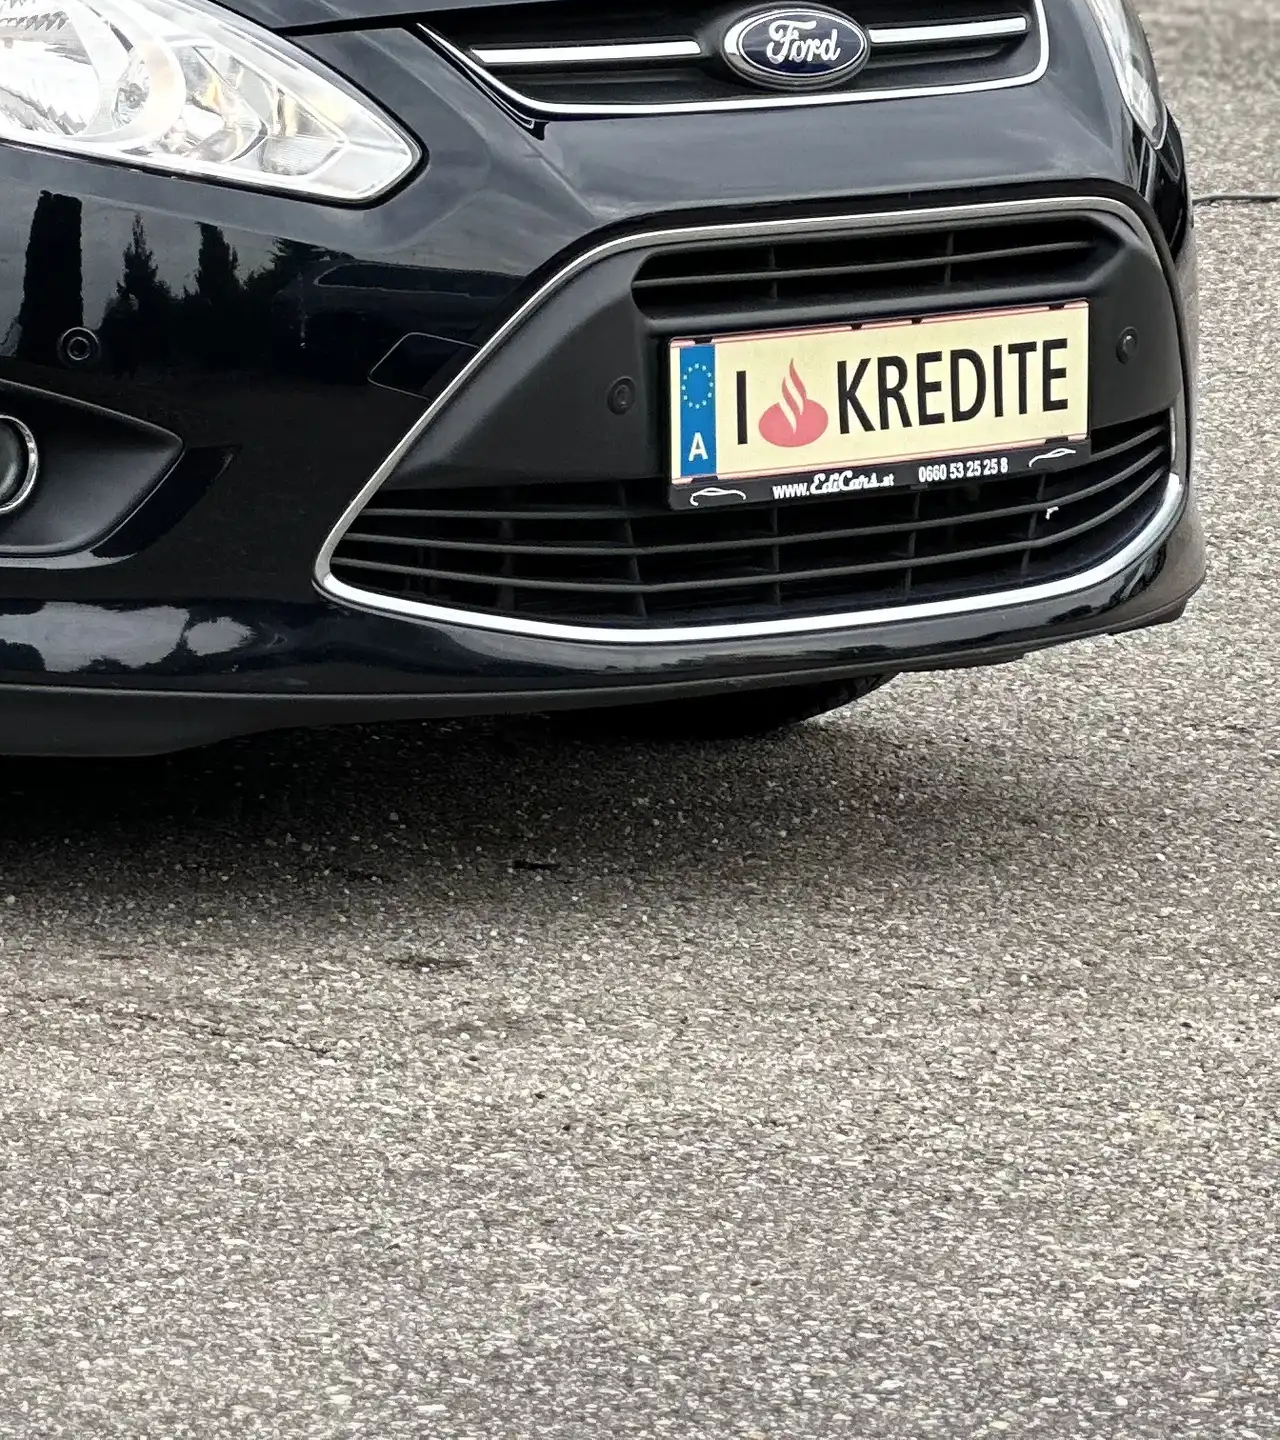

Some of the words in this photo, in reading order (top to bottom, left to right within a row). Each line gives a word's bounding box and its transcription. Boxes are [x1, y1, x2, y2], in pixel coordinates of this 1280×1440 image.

[766, 19, 841, 65] Ford
[837, 337, 1069, 435] KREDITE
[688, 432, 709, 462] A
[772, 469, 895, 500] www.EdiCars.at
[918, 463, 947, 483] 0660
[949, 461, 965, 479] 53
[966, 459, 981, 477] 25
